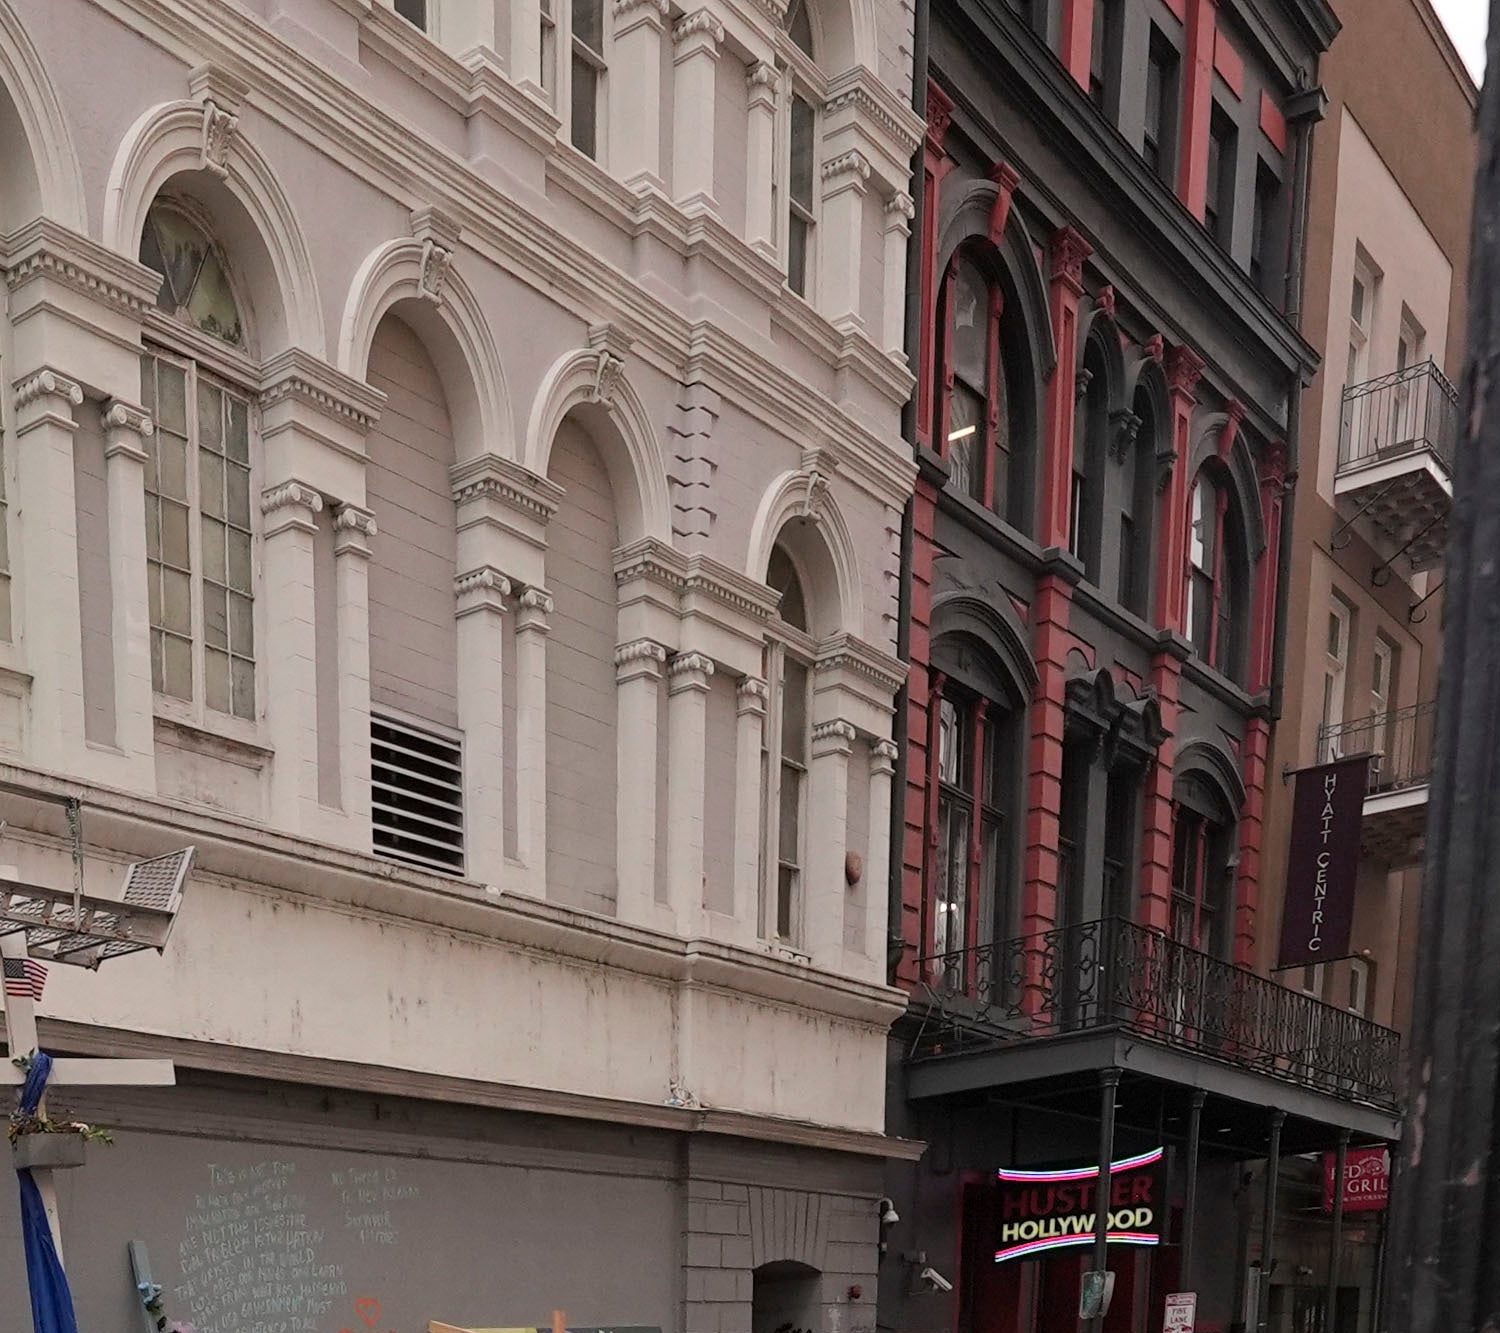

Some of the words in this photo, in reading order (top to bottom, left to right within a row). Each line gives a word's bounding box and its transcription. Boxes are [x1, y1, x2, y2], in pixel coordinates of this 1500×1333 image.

[1321, 773, 1337, 844] HYATT
[1309, 852, 1330, 951] CENTRIC
[1002, 1175, 1154, 1219] HUSTER
[1347, 1178, 1388, 1193] GRIL
